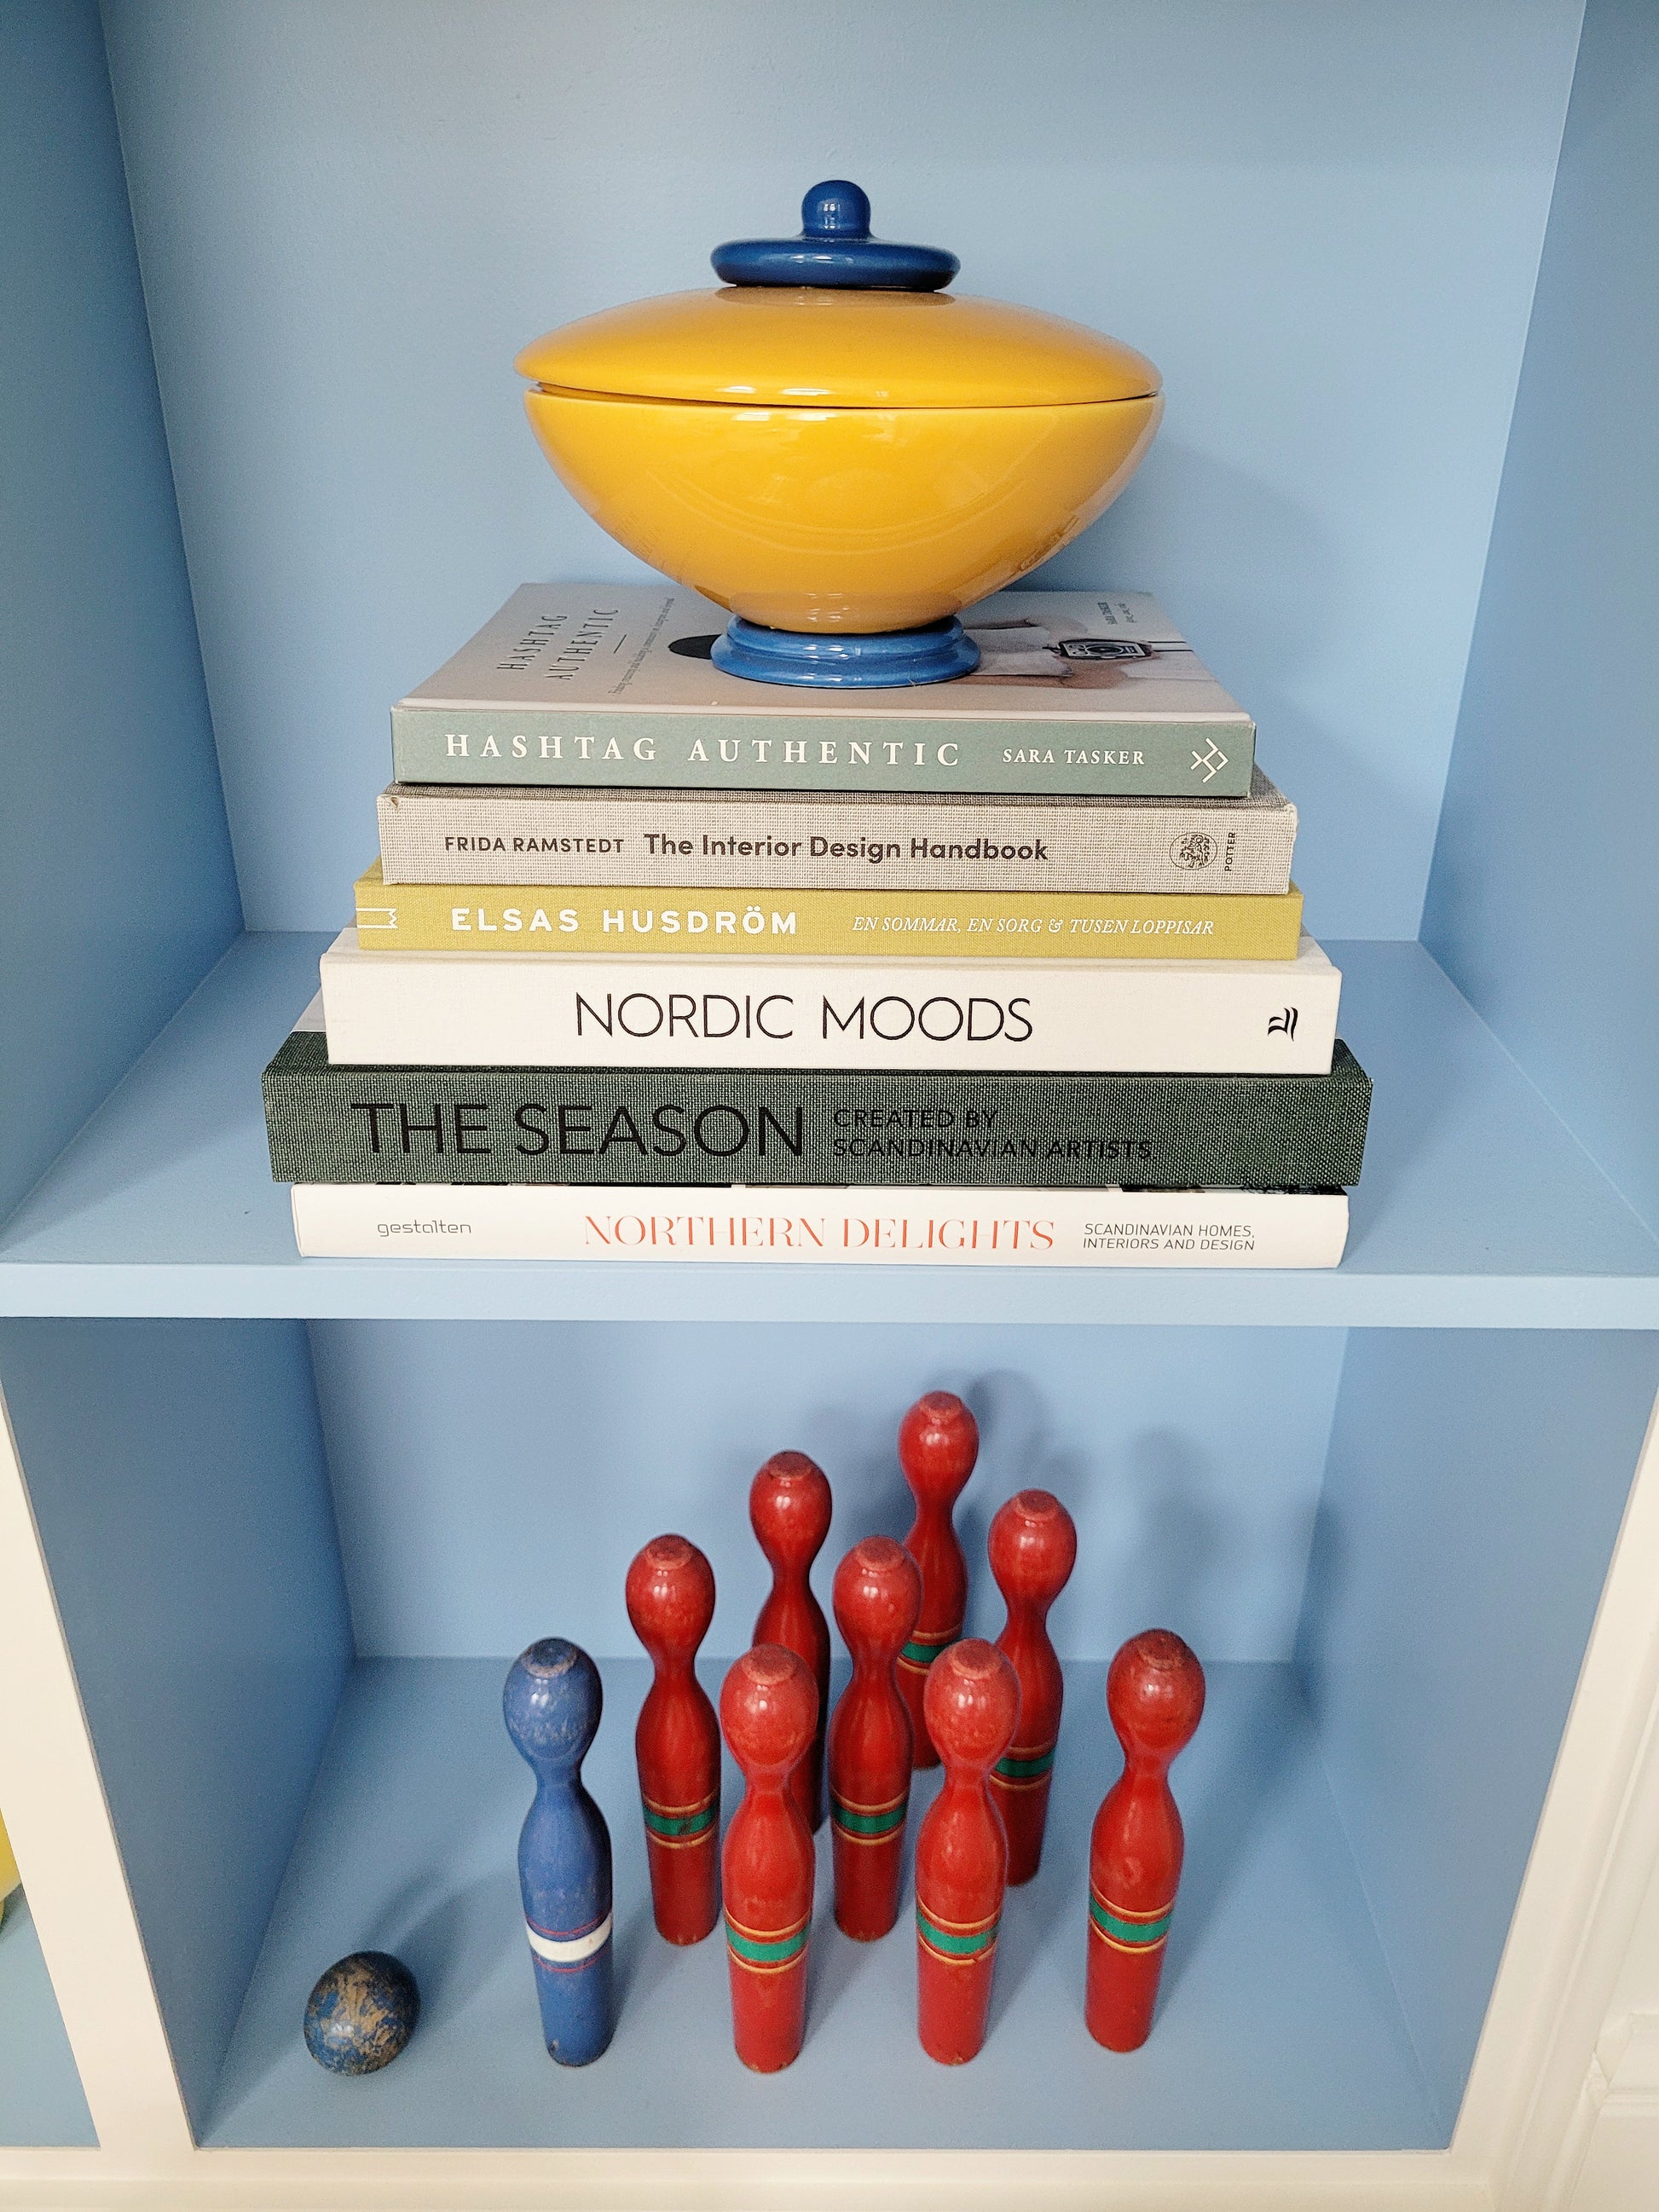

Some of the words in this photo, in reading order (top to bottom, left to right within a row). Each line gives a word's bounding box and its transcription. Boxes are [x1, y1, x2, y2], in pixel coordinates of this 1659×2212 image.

[497, 614, 567, 671] HASHTAG
[545, 609, 618, 680] AUTHENTIC
[445, 733, 658, 761] HASHTAG
[686, 739, 960, 767] AUTHENTIC
[1002, 748, 1056, 764] SARA
[1064, 750, 1145, 765] TASKER
[445, 835, 506, 852] FRIDA
[512, 837, 624, 853] RAMSTEDT
[644, 833, 693, 855] The
[702, 835, 801, 858] Interior
[809, 837, 901, 864] Design
[910, 839, 1049, 861] Handbook
[1223, 832, 1235, 872] POTTER
[451, 908, 581, 933] ELSAS
[602, 905, 798, 934] HUSDRÖM
[852, 916, 878, 932] EN
[882, 916, 962, 933] SOMMAR,
[966, 918, 993, 933] EN
[996, 918, 1043, 934] SORG
[1048, 919, 1063, 933] &
[1070, 919, 1129, 934] TUSEN
[1131, 920, 1214, 935] LOPPISAR
[576, 992, 794, 1039] NORDIC
[823, 996, 1033, 1042] MOODS
[351, 1102, 492, 1155] THE
[514, 1104, 804, 1157] SEASON
[833, 1108, 954, 1129] CREATED
[965, 1110, 998, 1129] BY
[832, 1137, 1038, 1158] SCANDINAVIAN
[1045, 1140, 1153, 1160] ARTISTS
[377, 1218, 472, 1237] gestalten
[584, 1216, 824, 1246] NORTHERN
[841, 1217, 1055, 1250] DELIGHTS
[1084, 1223, 1194, 1236] SCANDINAVIAN
[1198, 1224, 1256, 1239] HOMES,
[1082, 1237, 1159, 1250] INTERIORS
[1164, 1239, 1195, 1250] AND
[1199, 1239, 1255, 1251] DESIGN
